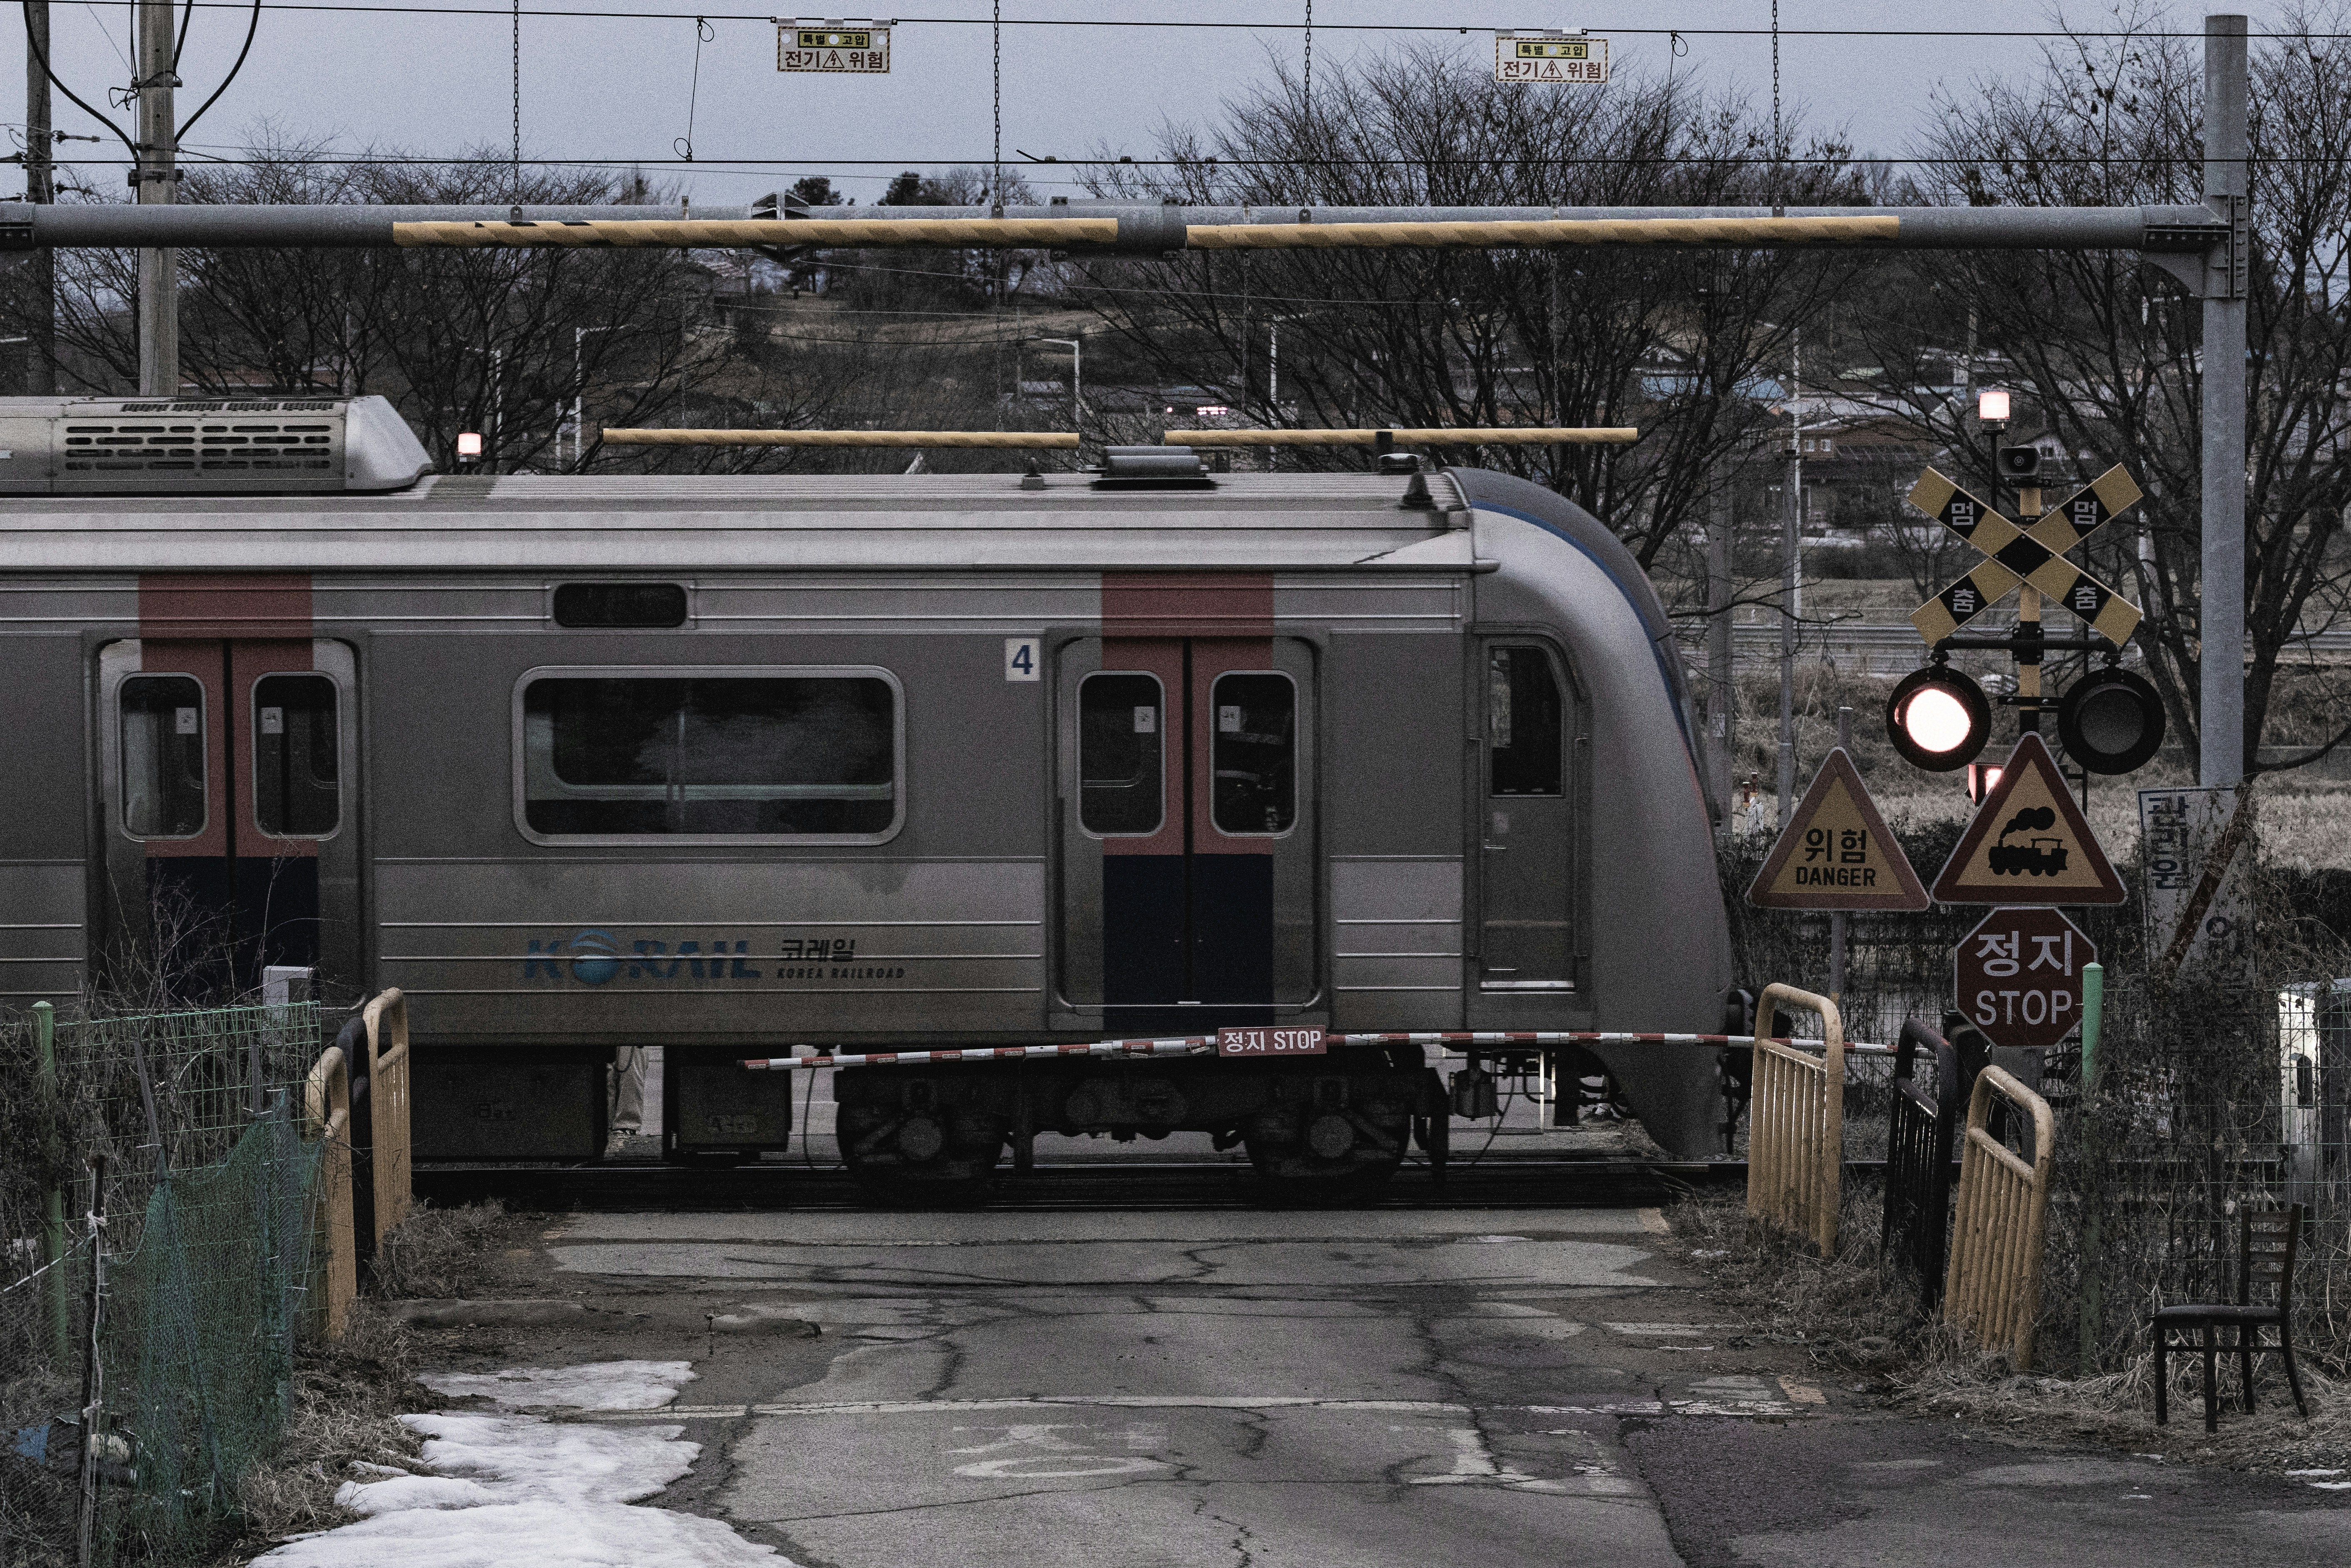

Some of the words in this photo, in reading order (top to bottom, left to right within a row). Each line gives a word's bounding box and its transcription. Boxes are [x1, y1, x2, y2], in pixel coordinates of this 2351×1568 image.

[803, 34, 825, 45] 특별
[842, 35, 866, 45] 고압
[1521, 45, 1544, 55] 특별
[1561, 46, 1583, 56] 고압
[785, 50, 820, 67] 전기
[849, 51, 883, 69] 위험
[1503, 61, 1538, 77] 전기
[1567, 62, 1601, 79] 위험
[1951, 502, 1974, 526] 멈
[2074, 501, 2097, 525] 멈
[1953, 588, 1975, 613] 춤
[2076, 586, 2097, 610] 춤
[1012, 644, 1033, 674] 4
[1805, 828, 1867, 864] 위험
[1796, 866, 1876, 886] DANGER
[524, 930, 761, 984] KORAIL
[779, 939, 855, 962] 코레일
[1975, 930, 2071, 976] 정지
[777, 967, 824, 979] KOREA
[831, 967, 905, 979] RAILROAD
[1975, 989, 2072, 1025] STOP
[1225, 1031, 1265, 1052] 정지
[1274, 1031, 1321, 1050] STOP
